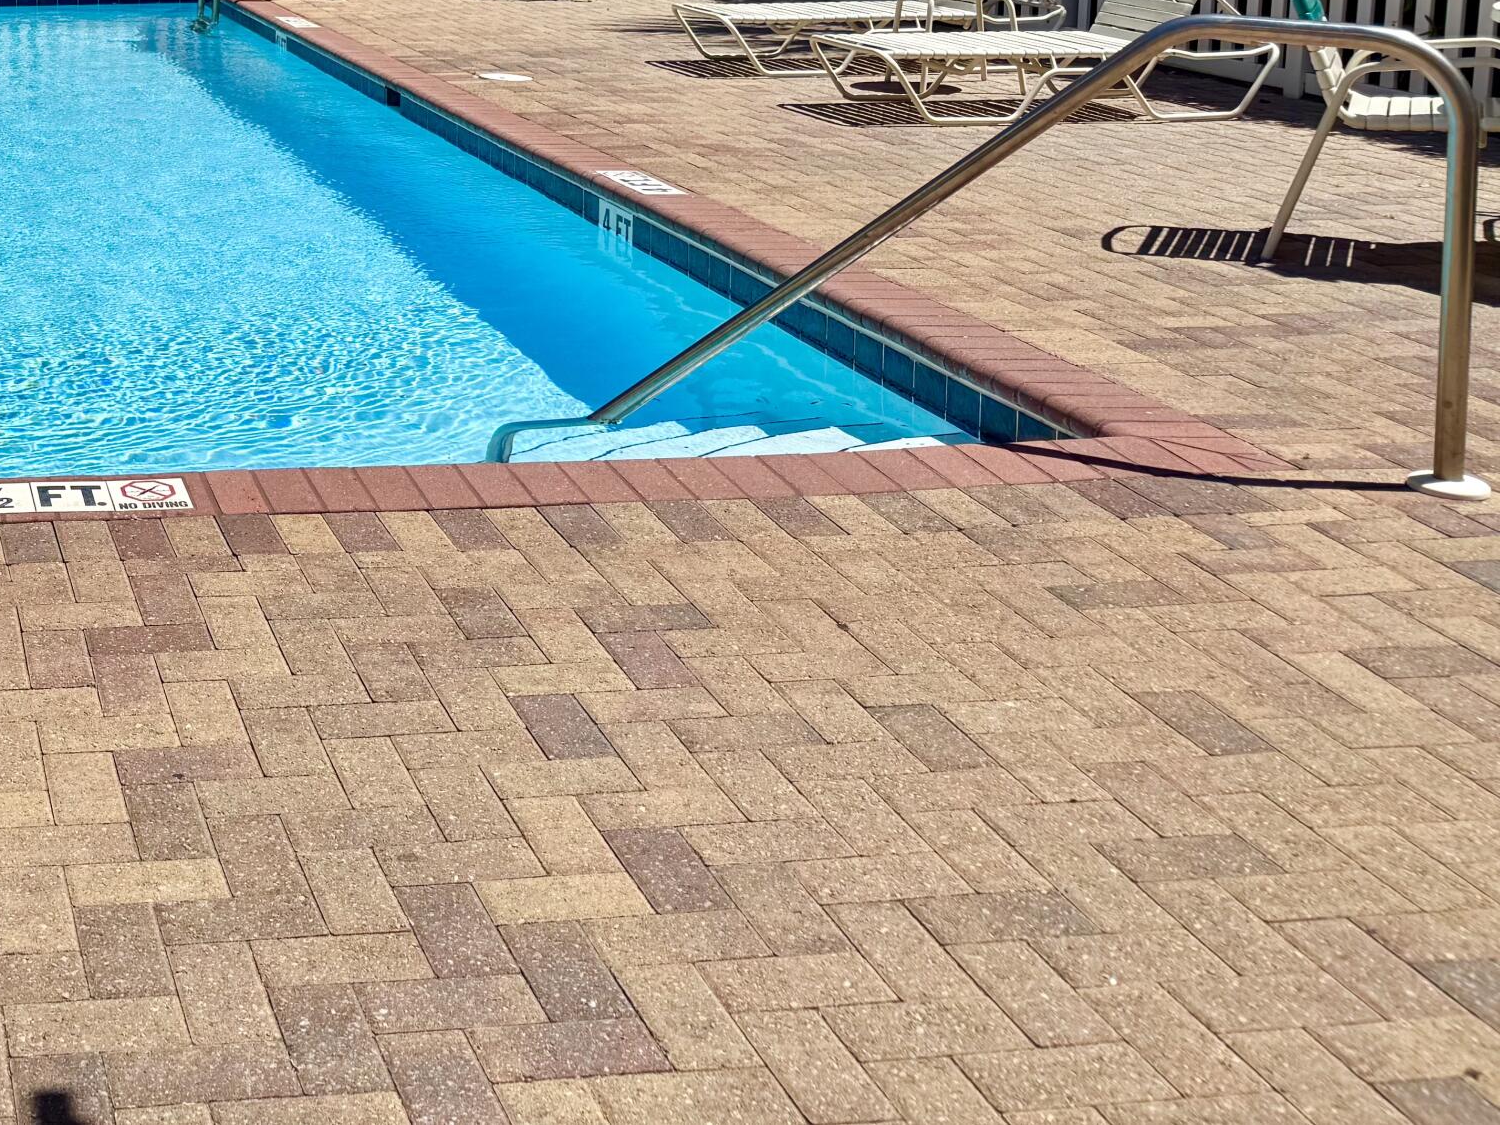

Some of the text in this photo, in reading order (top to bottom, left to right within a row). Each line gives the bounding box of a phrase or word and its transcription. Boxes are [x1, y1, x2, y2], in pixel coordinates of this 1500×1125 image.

[603, 208, 631, 242] 4 FT
[36, 485, 107, 507] FT.
[142, 501, 189, 509] DIVING
